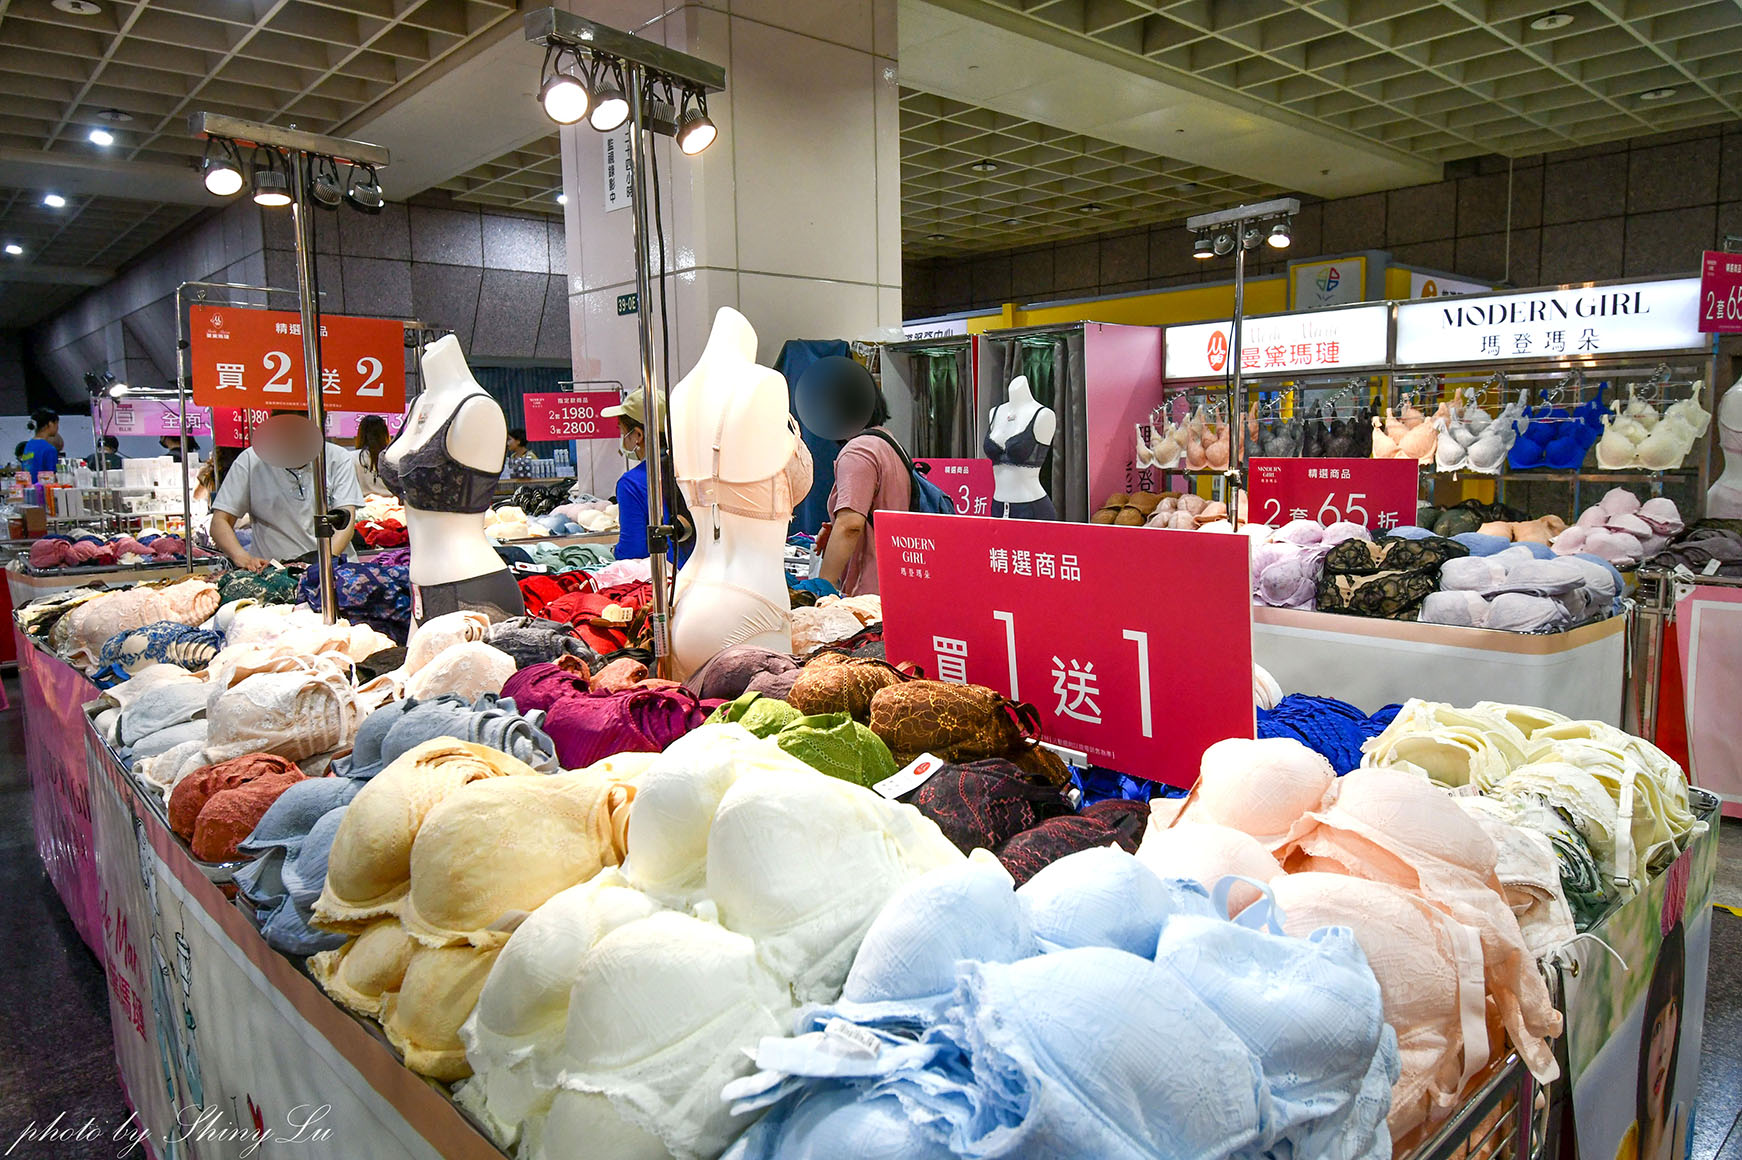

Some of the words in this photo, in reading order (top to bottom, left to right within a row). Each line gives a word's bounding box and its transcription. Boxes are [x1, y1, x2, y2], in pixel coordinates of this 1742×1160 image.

[1442, 298, 1567, 329] MODERN
[1576, 291, 1649, 318] GIRL
[275, 322, 329, 337] 精選品
[1481, 328, 1599, 356] 瑪登瑪朵
[1241, 341, 1340, 369] 曼黛瑪璉
[1308, 469, 1351, 479] 精選商品
[956, 485, 987, 515] 3折
[891, 535, 936, 551] MODERN
[902, 551, 927, 565] GIRL
[989, 548, 1081, 581] 精選商品
